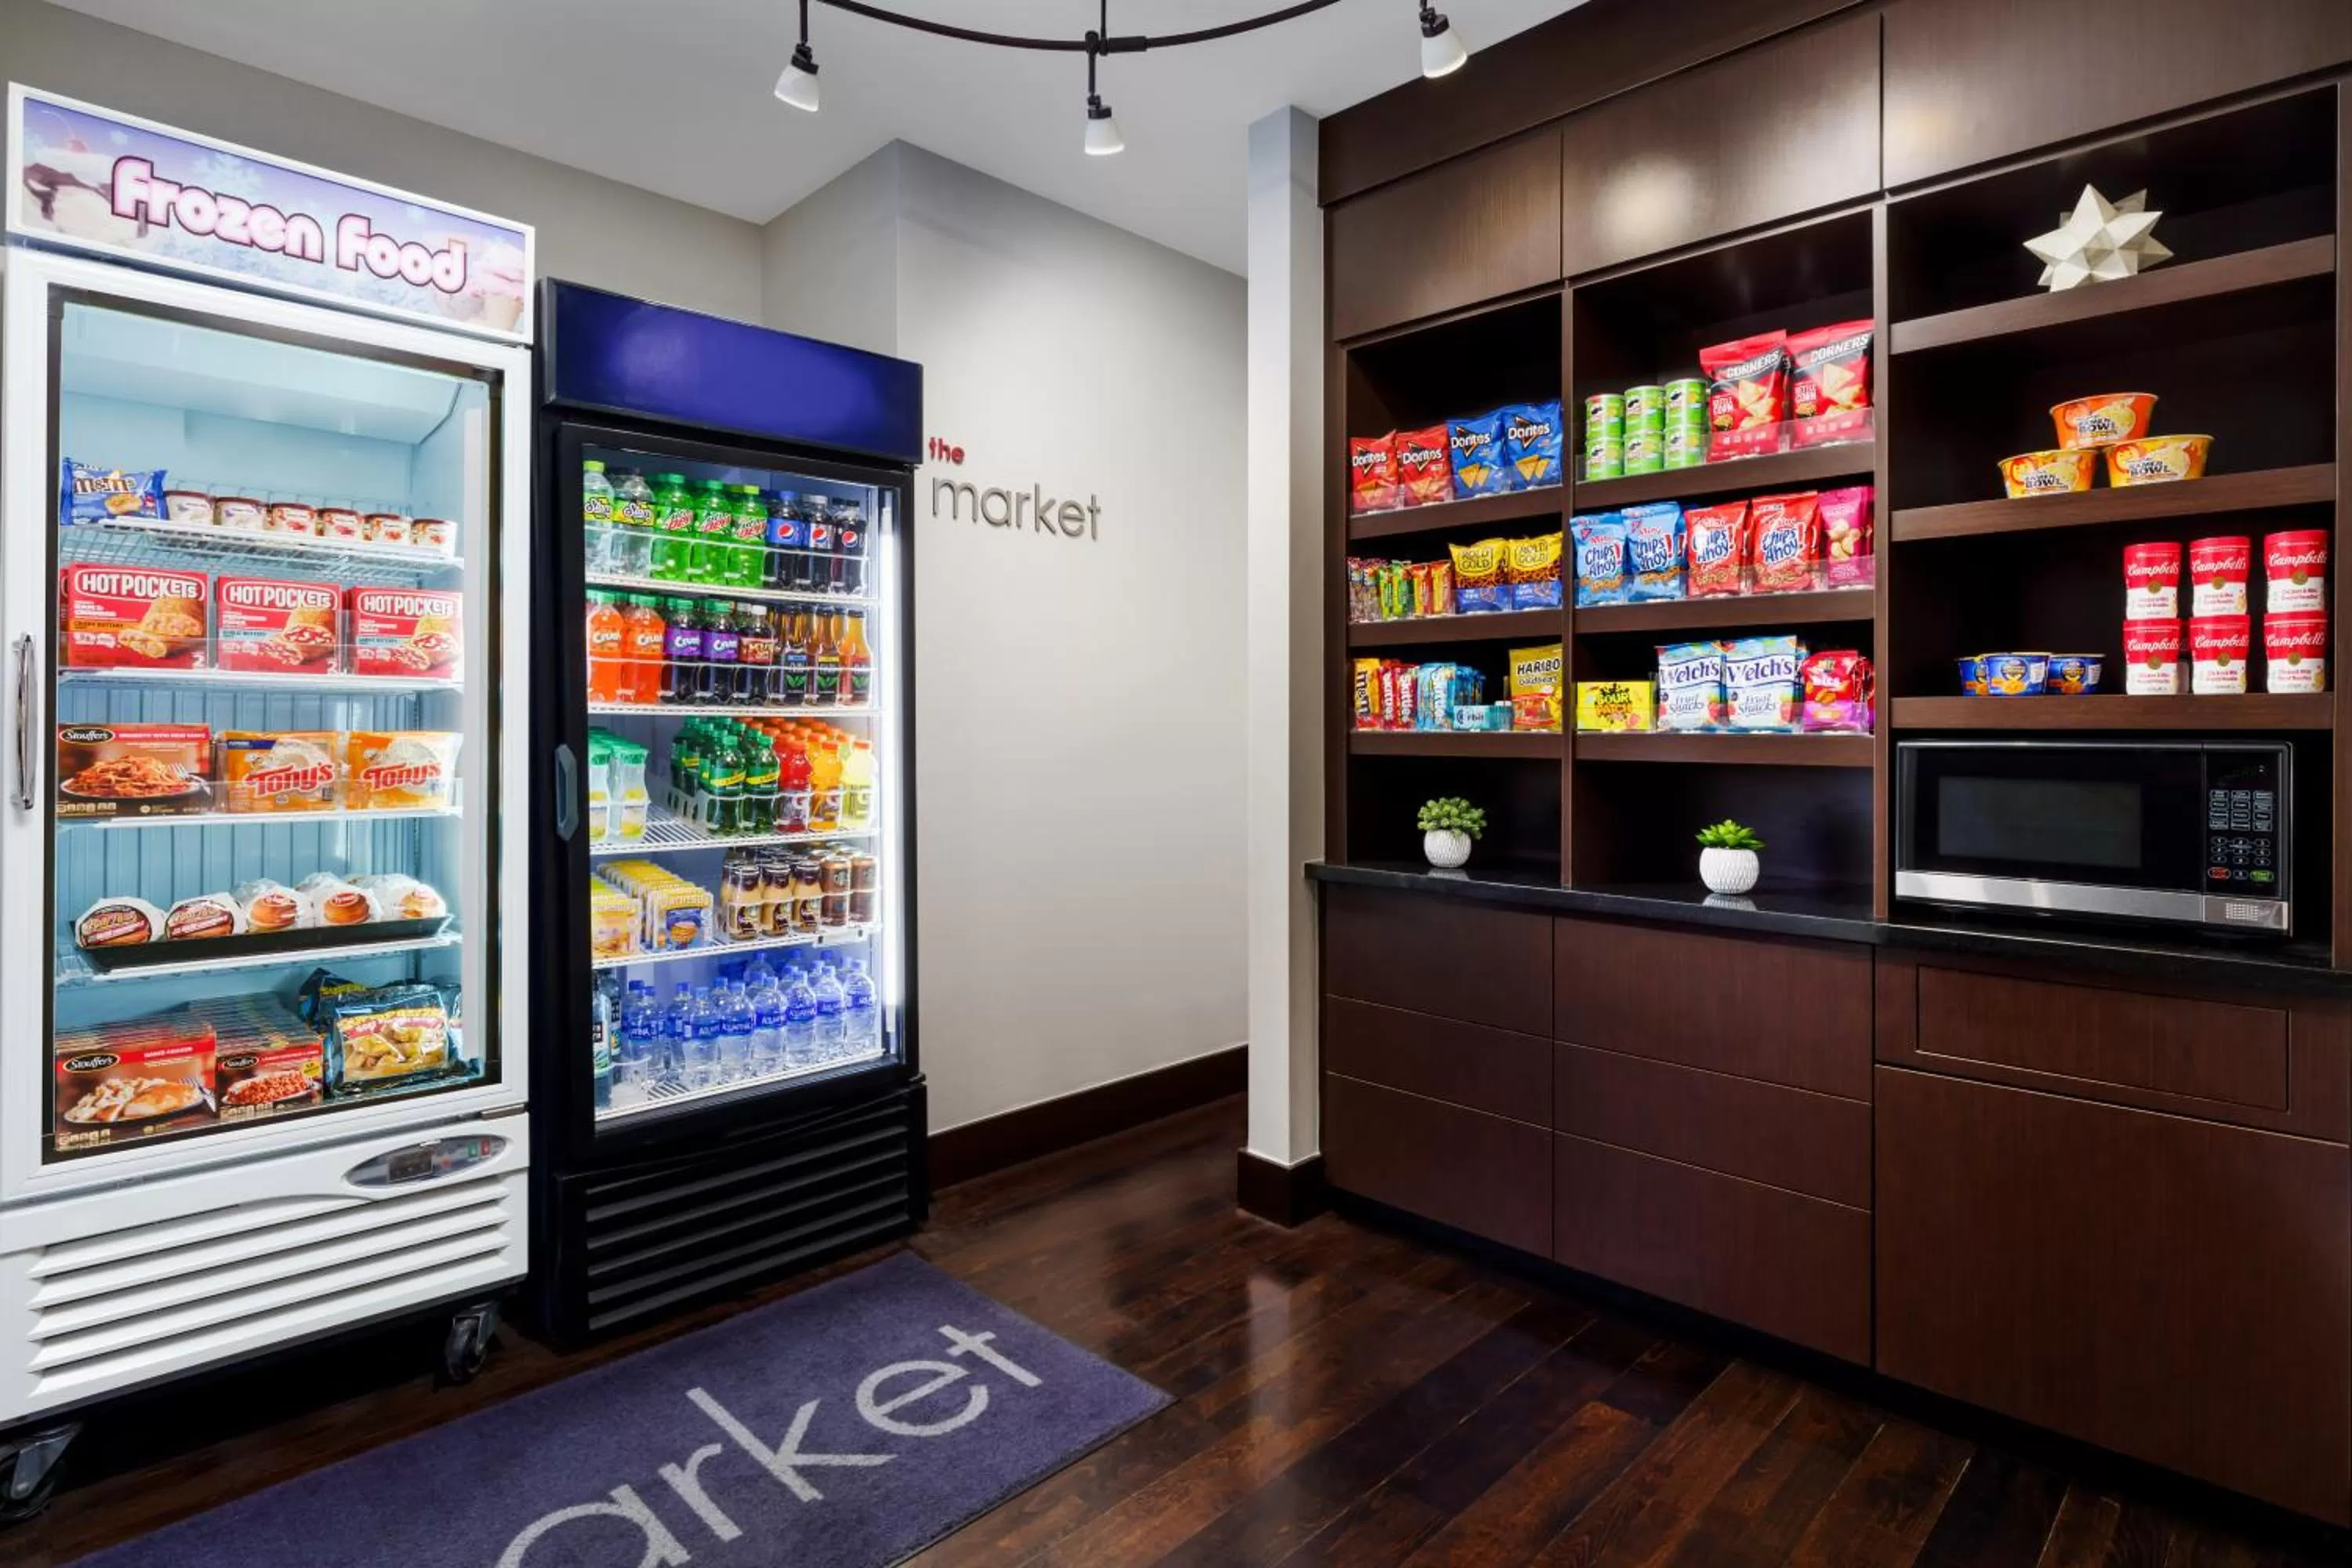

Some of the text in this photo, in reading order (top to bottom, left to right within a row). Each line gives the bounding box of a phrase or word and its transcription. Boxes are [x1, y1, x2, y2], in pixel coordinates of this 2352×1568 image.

[1450, 434, 1490, 449] Doritos
[1508, 423, 1550, 440] Doritos
[929, 437, 965, 466] the
[1352, 452, 1387, 467] Doritos
[1403, 448, 1442, 465] Doritos
[932, 477, 1101, 541] market
[82, 573, 198, 599] HOT POCKETS
[229, 586, 332, 608] HOT POCKETS
[363, 595, 394, 614] HOT
[1517, 658, 1561, 675] HARIBO
[1659, 661, 1719, 685] Welch's
[1726, 658, 1793, 682] Welch's
[244, 761, 334, 797] Tony's
[362, 762, 442, 791] Tony's
